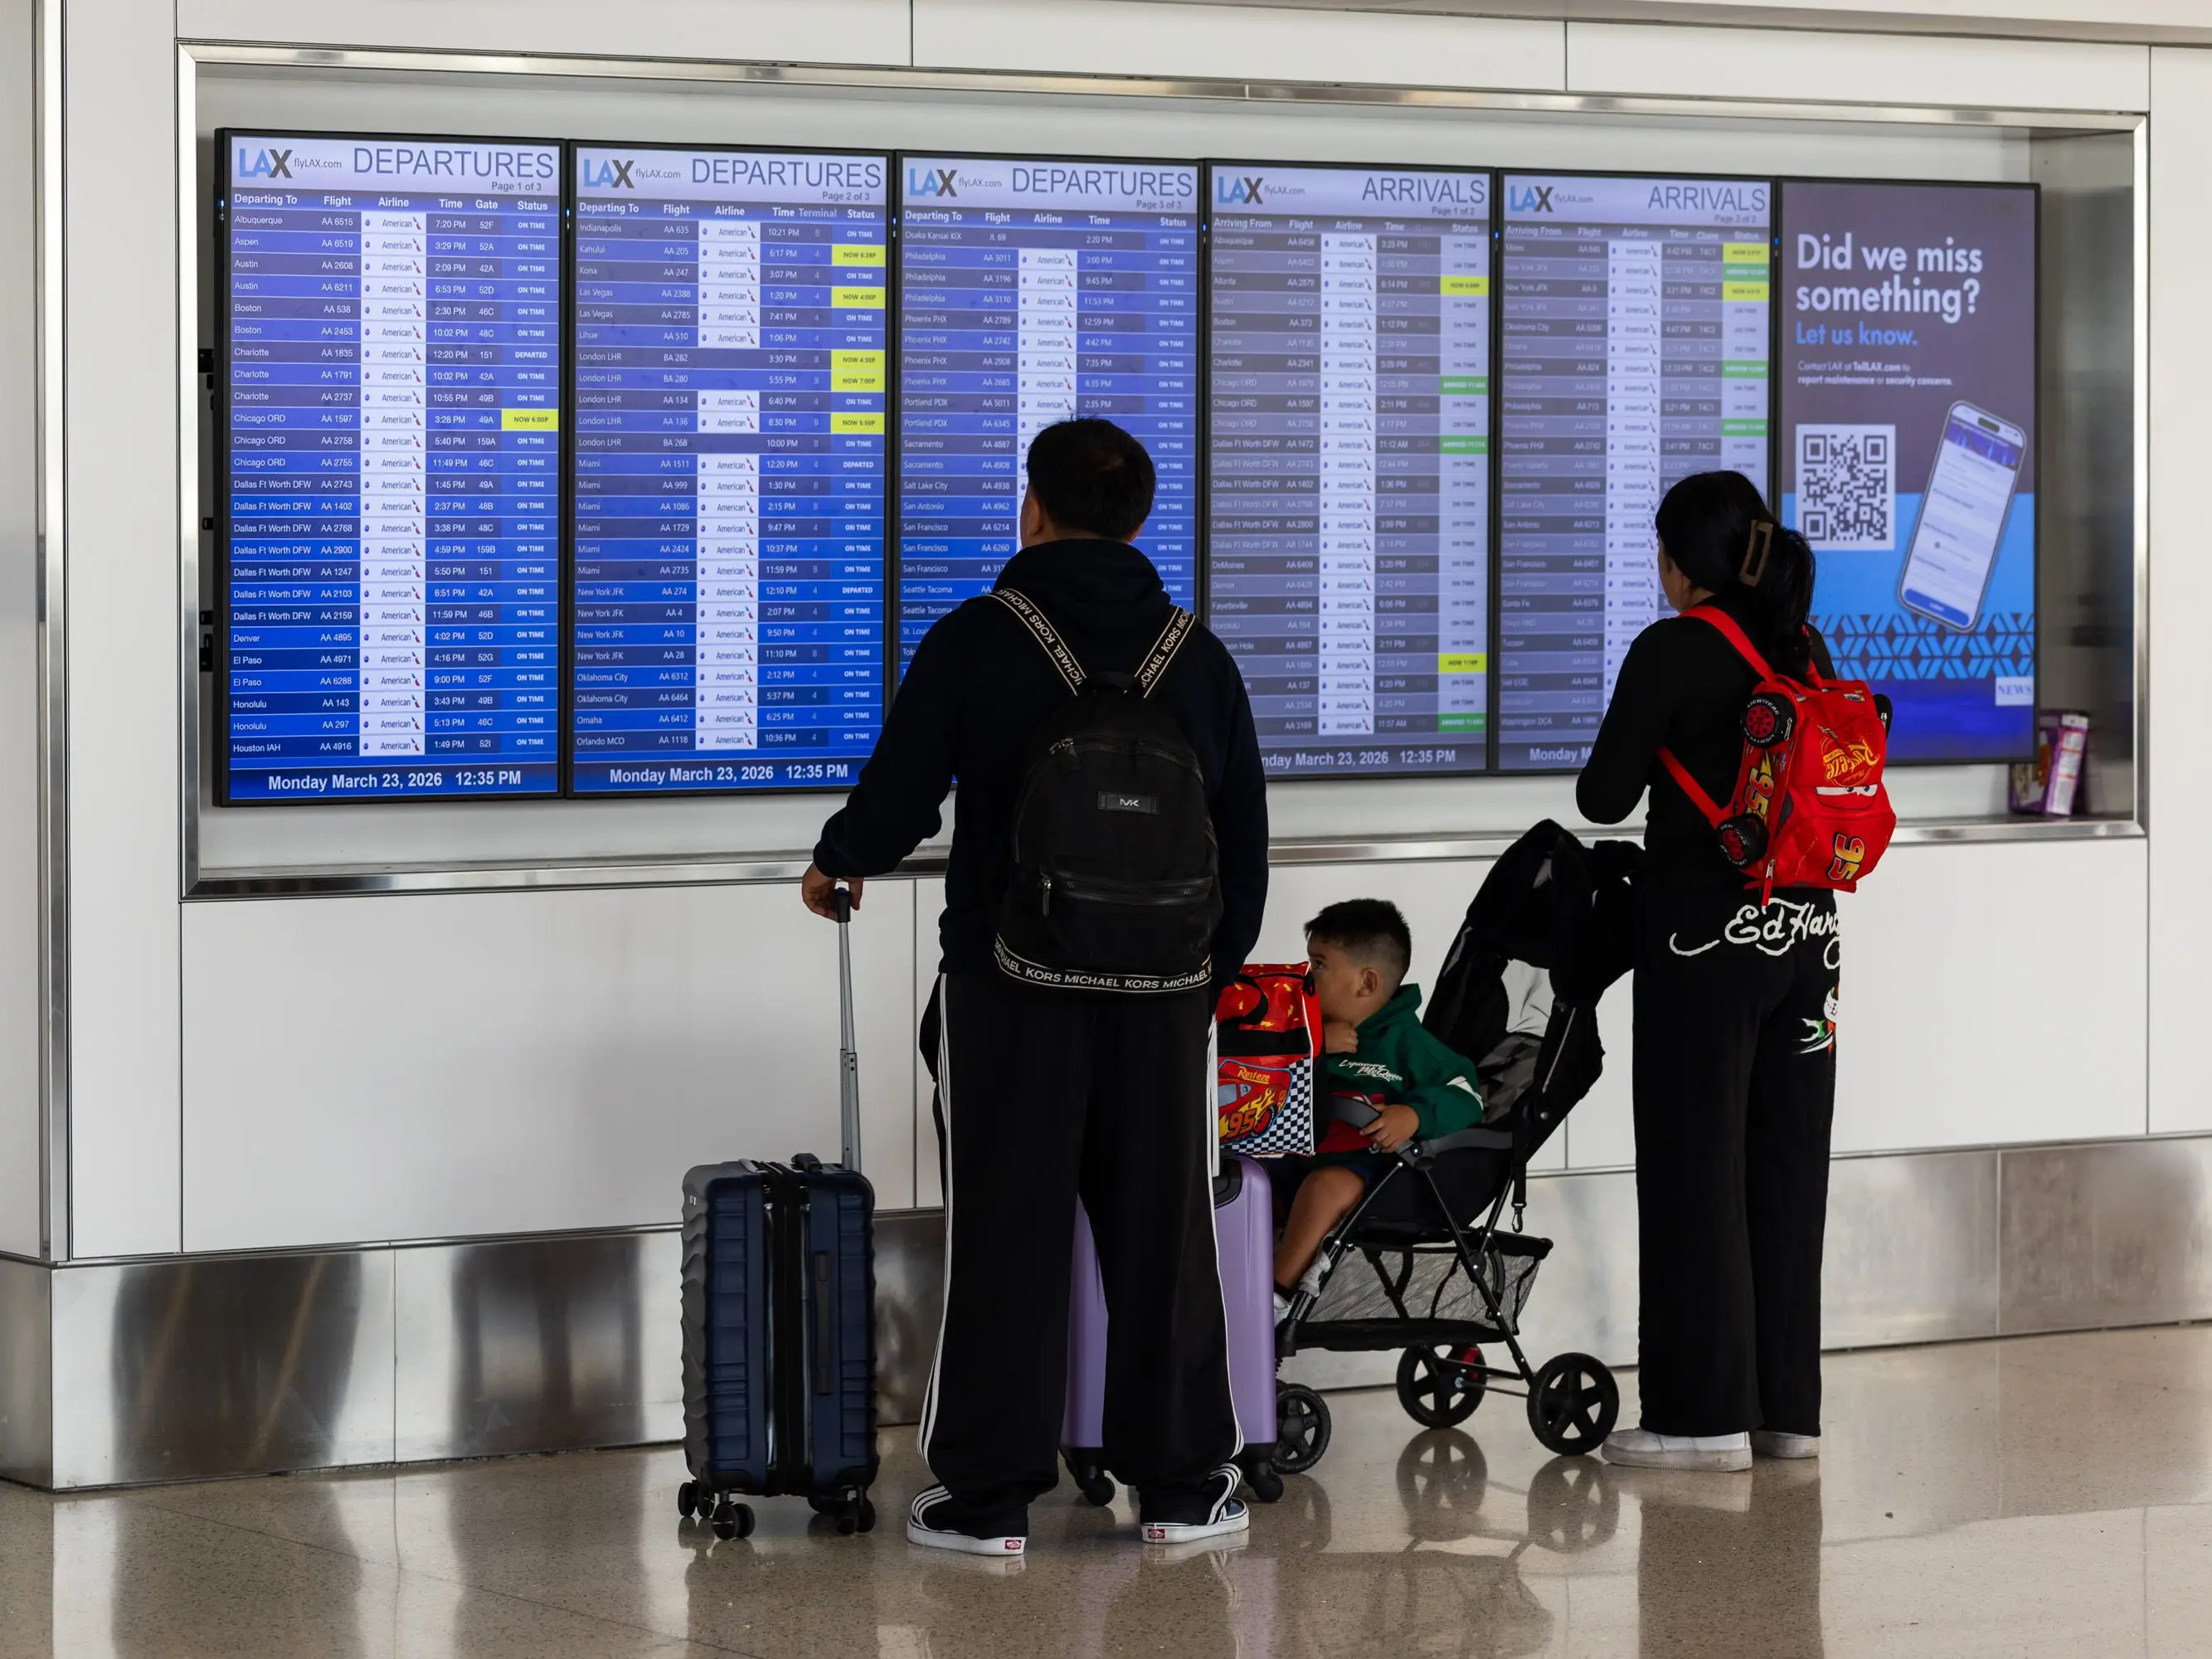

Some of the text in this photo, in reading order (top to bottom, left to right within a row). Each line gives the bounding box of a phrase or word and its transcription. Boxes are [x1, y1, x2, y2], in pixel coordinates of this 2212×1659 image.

[240, 148, 553, 178] LAX flyLAX.com DEPARTURES
[584, 159, 881, 188] LAX flyLAX.com DEPARTURES
[492, 182, 542, 192] Page 1 of 3
[909, 168, 1192, 197] LAX flyLAX.com DEPARTURES
[1218, 177, 1485, 204] LAX flyLAX.com ARRIVALS
[235, 194, 547, 211] Departing To Flight Airline Time Gate Status
[823, 192, 869, 202] Page 2 of 3
[1136, 200, 1156, 210] Page
[1166, 201, 1174, 209] of
[1510, 185, 1765, 212] LAX flyLAX.com ARRIVALS
[580, 203, 874, 219] Departing To Flight Airline Time Terminal Status
[906, 212, 1186, 227] Departing To Flight Airline Time Status
[1432, 207, 1451, 216] Page
[1714, 215, 1733, 224] Page
[1743, 215, 1749, 223] of
[235, 216, 282, 226] Albuquerque
[322, 217, 333, 226] AA
[335, 217, 352, 226] 6515
[382, 219, 411, 229] American
[435, 220, 450, 229] 7:20
[452, 221, 466, 229] PM
[480, 221, 493, 229] 52F
[1214, 219, 1477, 233] Arriving From Flight Airline Time Status
[1506, 226, 1759, 241] Arriving From Flight Airline Time Claim Status
[1798, 232, 1982, 273] Did we miss
[1796, 274, 1980, 324] something?
[1796, 321, 1917, 346] Let us know.
[1798, 361, 1826, 372] Contact
[1828, 362, 1842, 372] LAX
[1798, 375, 1822, 387] report
[1824, 375, 1874, 385] maintenance
[1885, 376, 1915, 387] security
[934, 482, 948, 491] City
[1029, 615, 1055, 644] KORS
[1161, 627, 1181, 653] KORS
[1998, 685, 2031, 695] NEWS
[577, 715, 602, 725] Omaha
[659, 714, 670, 722] AA
[672, 714, 688, 723] 6412
[716, 714, 744, 723] American
[767, 713, 780, 721] 6:25
[1262, 751, 1456, 768] nday March 23, 2026 12:35 PM
[1530, 748, 1578, 762] Monday
[269, 771, 520, 791] Monday March 23, 2026 12:35 PM
[610, 765, 848, 784] Monday March 23, 2026 12:35 PM
[1745, 766, 1775, 816] 95
[1120, 798, 1139, 807] MK
[1826, 833, 1864, 881] 95
[1025, 967, 1208, 989] KORS MICHAEL KORS MICHAEL
[1228, 1108, 1257, 1137] 95
